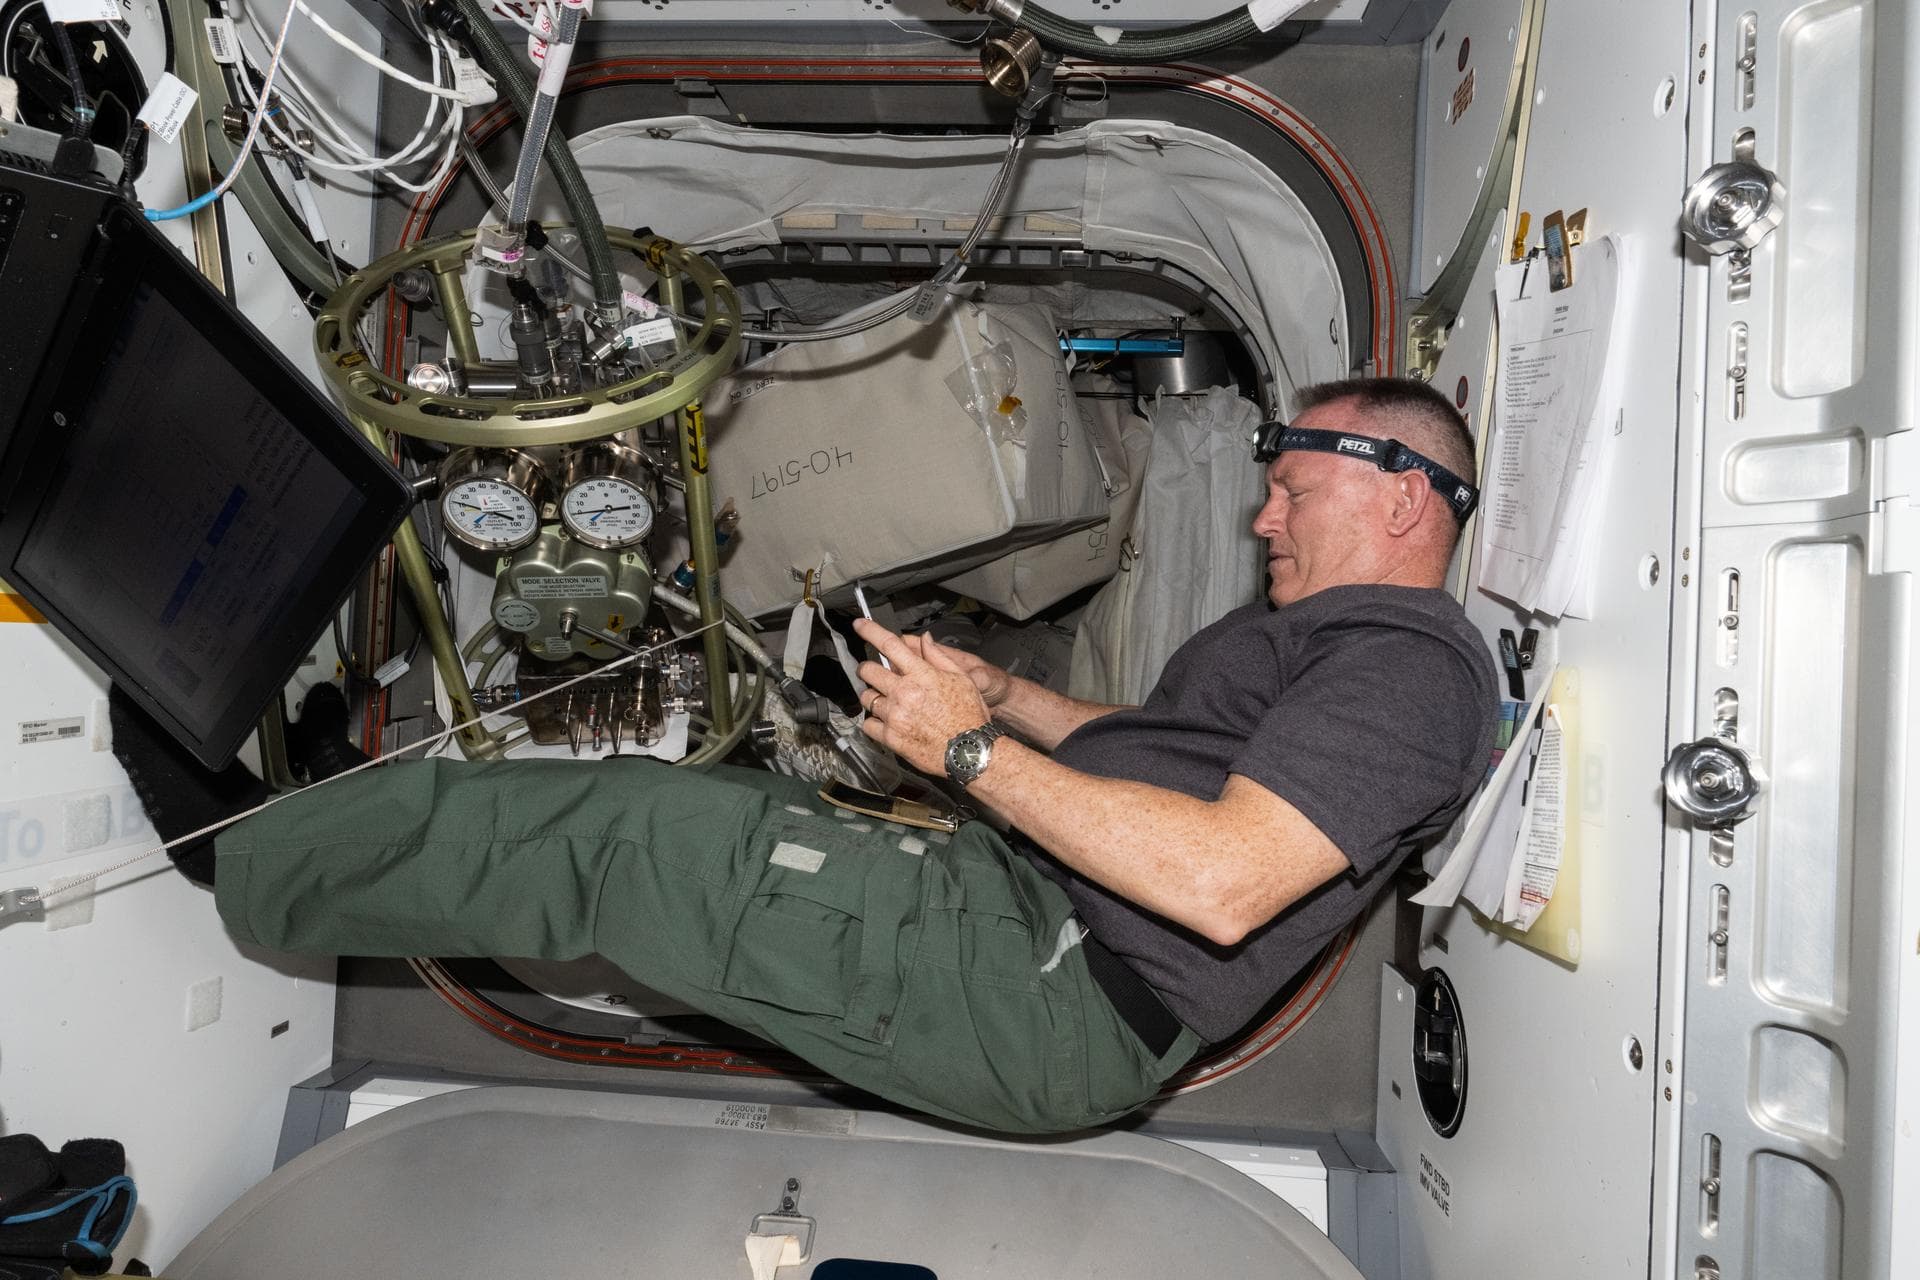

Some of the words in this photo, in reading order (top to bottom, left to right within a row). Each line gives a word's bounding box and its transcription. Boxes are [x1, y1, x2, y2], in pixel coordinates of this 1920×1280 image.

[1337, 437, 1375, 454] PETZL
[543, 576, 579, 584] SELECTION
[745, 1121, 765, 1130] ASSY
[1420, 1152, 1433, 1176] FWD
[1434, 1168, 1450, 1196] STBD
[1430, 1183, 1450, 1217] VALVE
